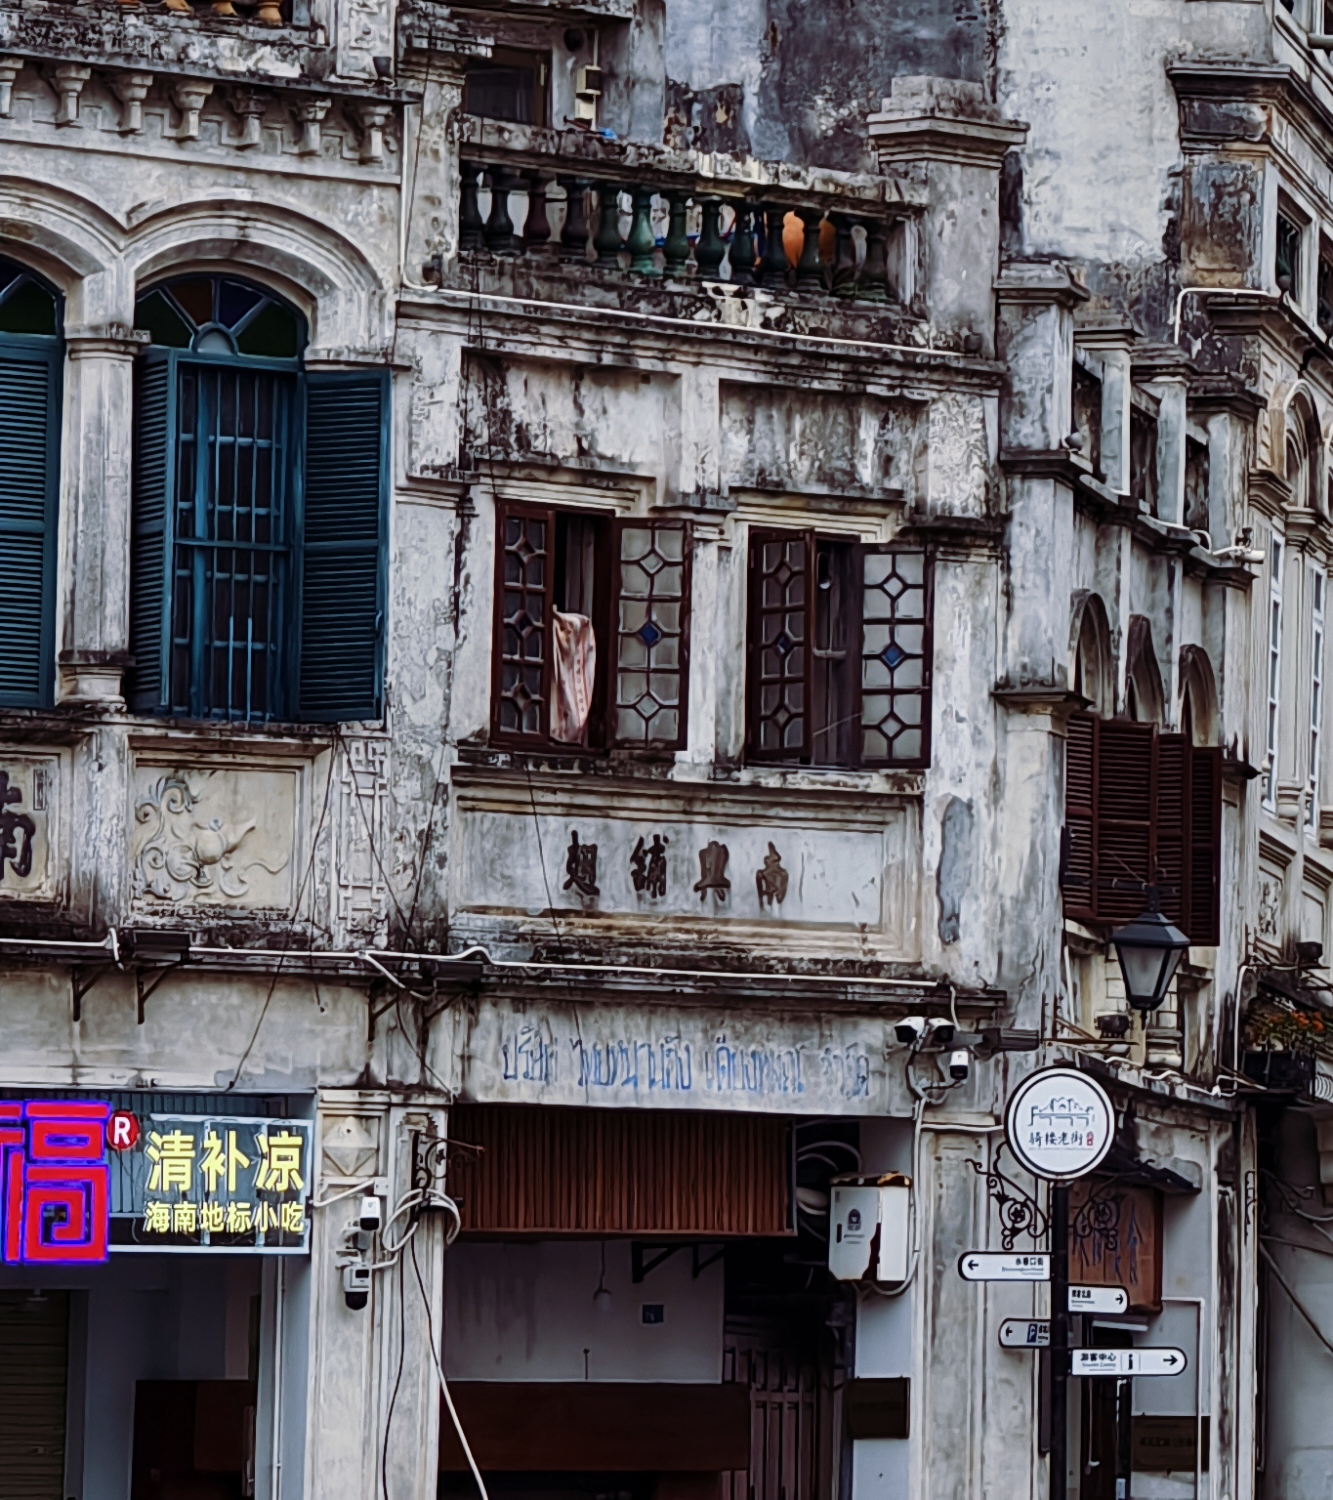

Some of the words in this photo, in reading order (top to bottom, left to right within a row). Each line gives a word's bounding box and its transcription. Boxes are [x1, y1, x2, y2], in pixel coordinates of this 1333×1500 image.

[145, 1129, 304, 1193] 清补凉
[145, 1201, 304, 1234] 海南地标小吃
